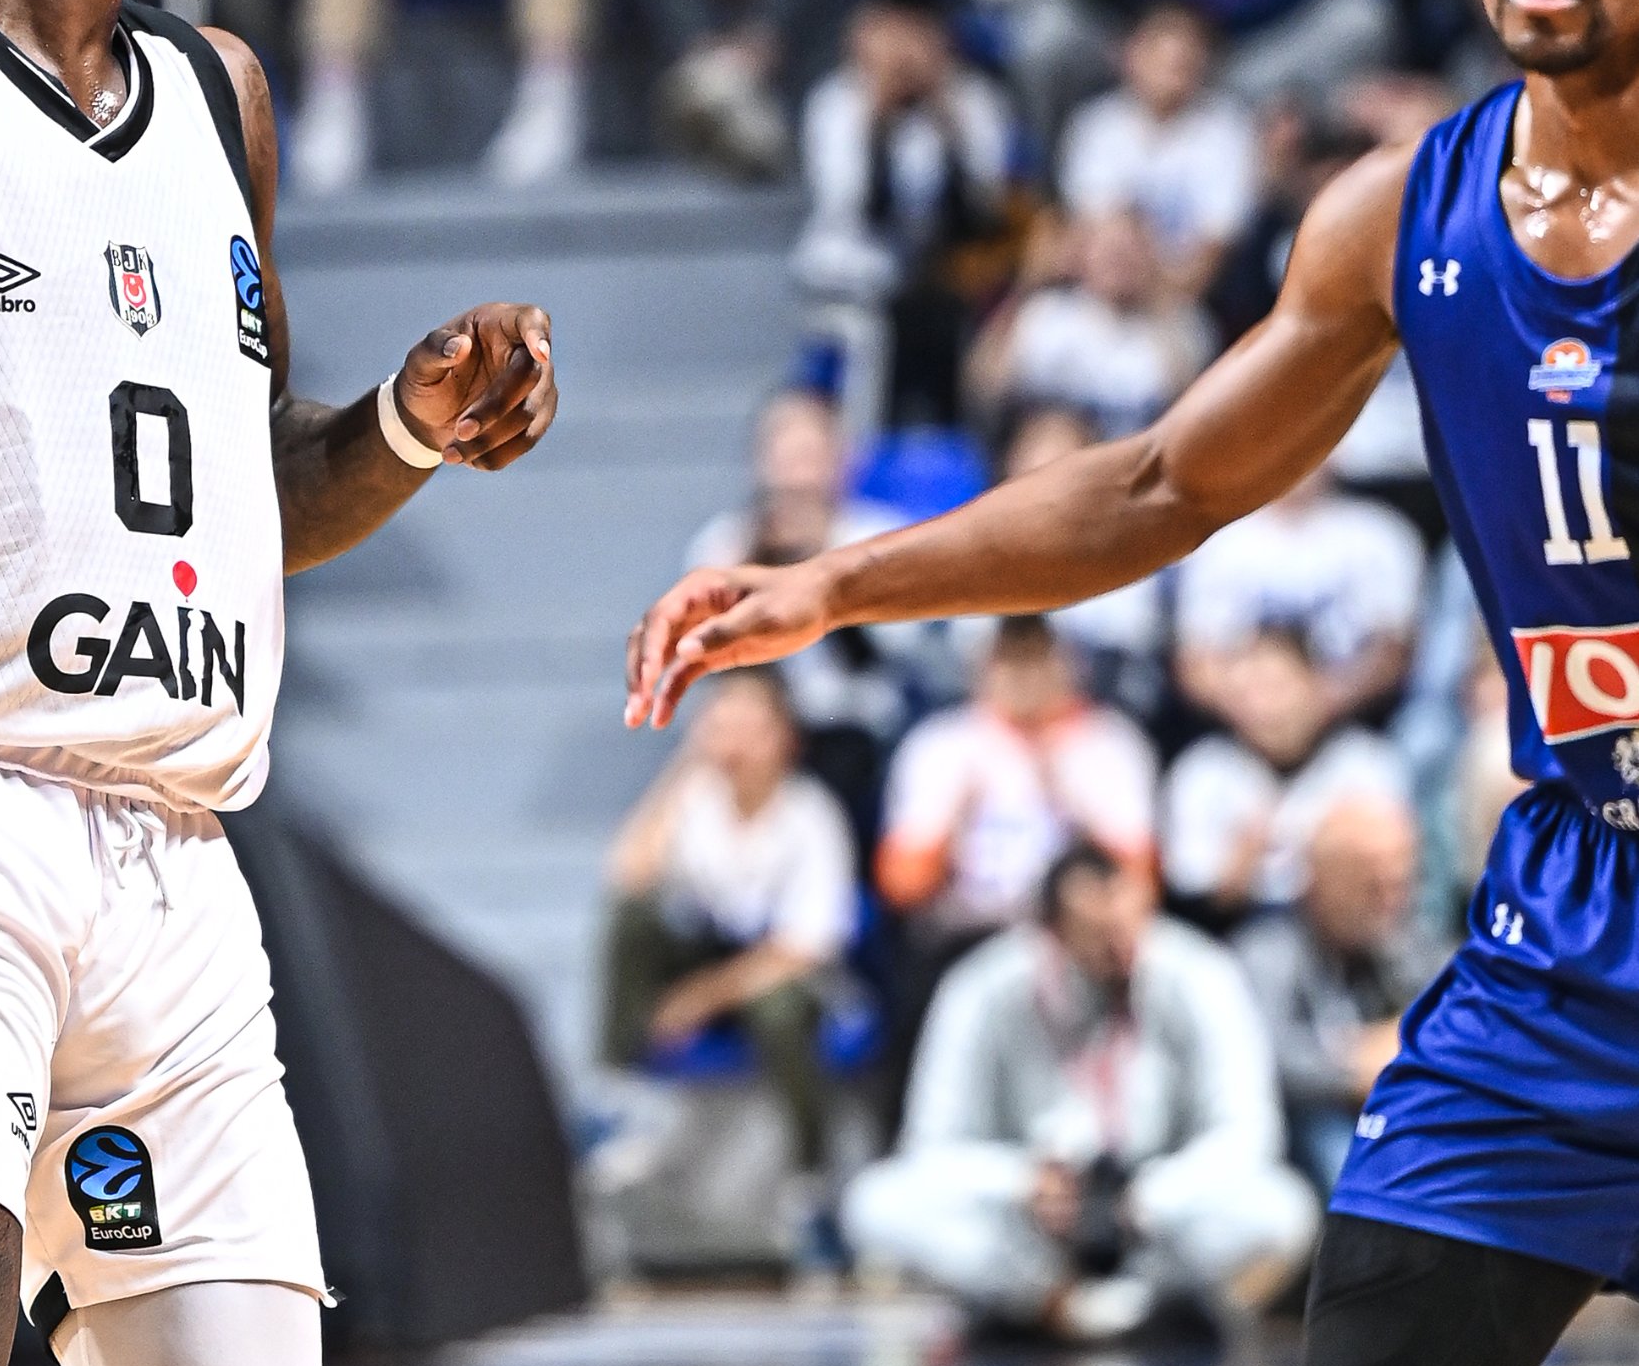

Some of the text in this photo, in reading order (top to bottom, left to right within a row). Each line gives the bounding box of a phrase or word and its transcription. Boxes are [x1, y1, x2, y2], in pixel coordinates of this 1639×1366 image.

[112, 248, 148, 271] BJK
[125, 309, 156, 325] 1903
[109, 380, 193, 537] 0
[1527, 418, 1631, 566] 11
[89, 1201, 141, 1223] BKT
[91, 1225, 153, 1240] EuroCup
